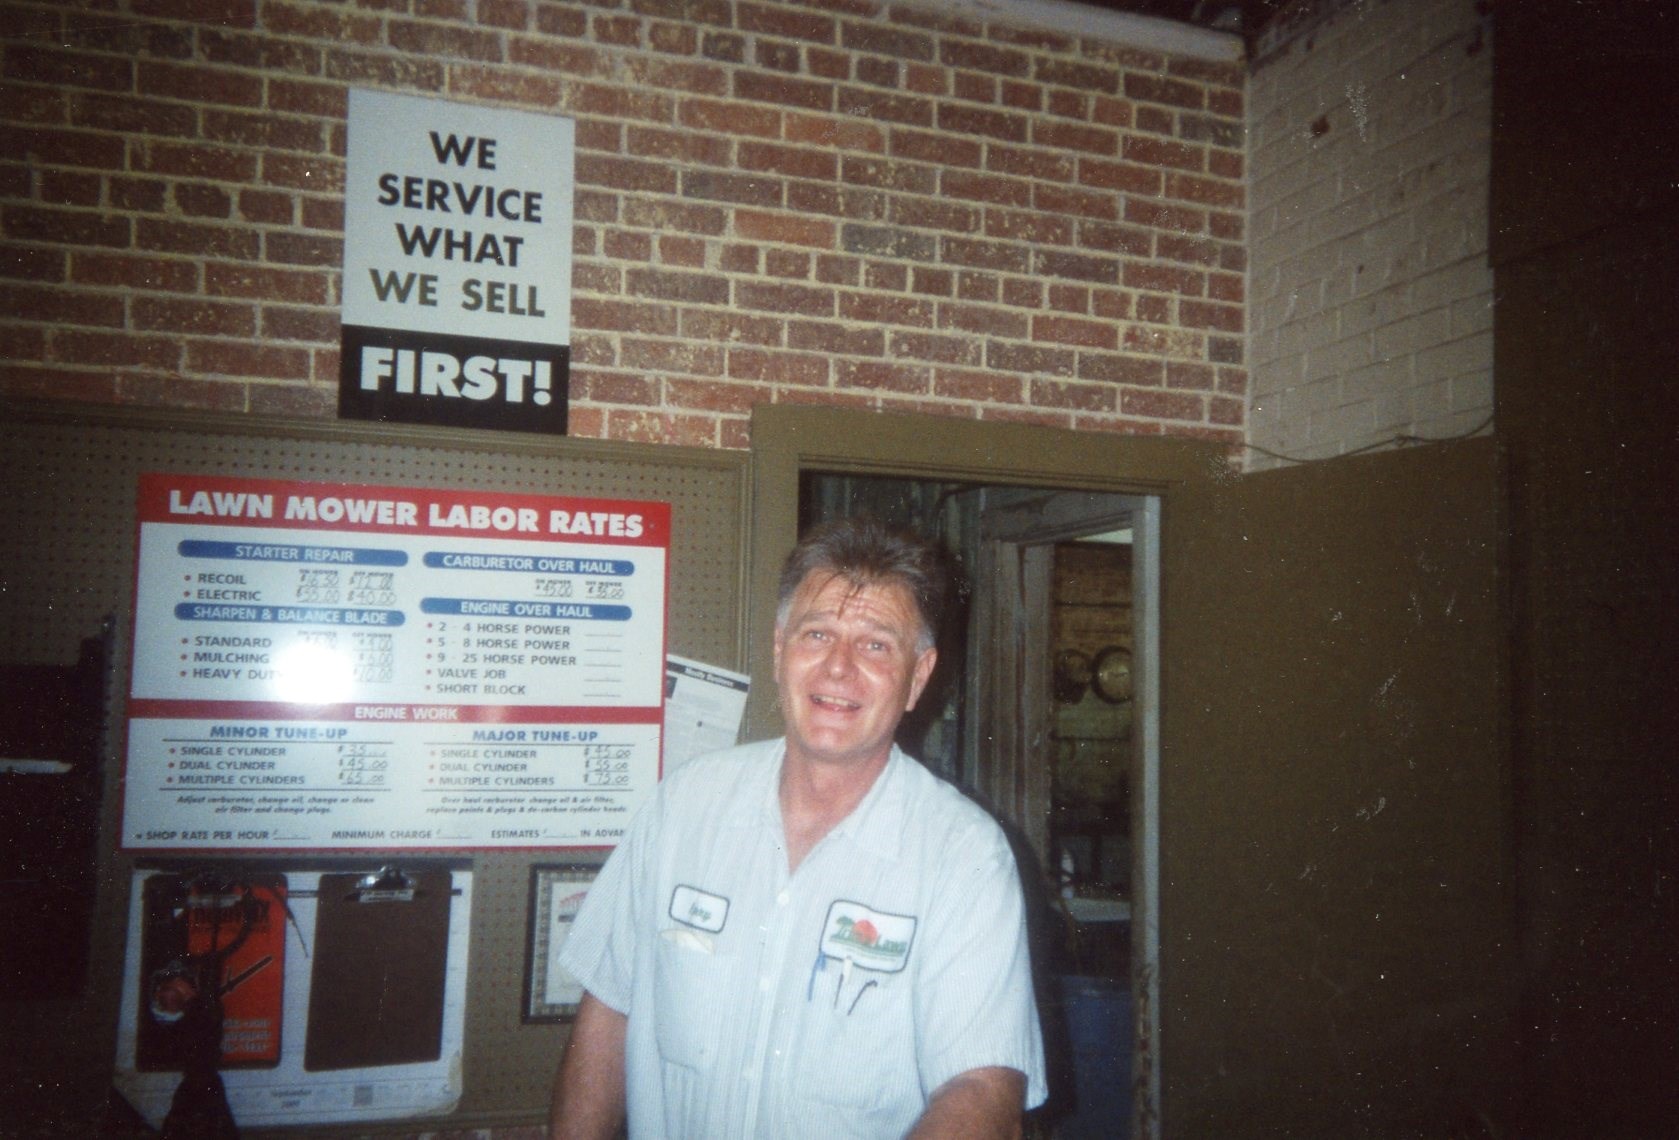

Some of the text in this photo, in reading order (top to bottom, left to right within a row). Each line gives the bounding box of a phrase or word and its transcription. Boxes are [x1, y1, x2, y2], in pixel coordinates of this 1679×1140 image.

[429, 131, 497, 170] WE
[377, 173, 543, 223] SERVICE
[395, 223, 524, 267] WHAT
[369, 268, 546, 318] WE SELL
[360, 345, 552, 406] FIRST!
[169, 489, 643, 537] LAWN MOWER LABOR RATES
[235, 545, 355, 563] STARTER REPAIR
[443, 554, 616, 574] CARBURETOR OVER HAUL
[197, 573, 247, 585] RECOIL
[197, 589, 261, 602] ELECTRIC
[193, 606, 388, 625] SHARPEN & BALANCE BLADE
[460, 602, 593, 618] ENGINE OVER HAUL
[438, 622, 570, 635] 2 4 HORSE POWER
[194, 636, 272, 648] STANDARD
[438, 637, 570, 651] 5 8 HORSE POWER
[193, 652, 270, 664] MULCHING
[437, 652, 577, 666] 9 25 HORSE POWER
[193, 668, 241, 680] HEAVY
[438, 668, 506, 680] VALVE JOB
[437, 683, 526, 695] SHORT BLOCK
[355, 706, 458, 720] ENGINE WORK
[210, 726, 348, 739] MINOR TUNE-UP
[473, 730, 599, 742] MAJOR TUNE-UP
[180, 746, 286, 757] SINGLE CYLINDER
[440, 748, 537, 759] SINGLE CYLINDER
[180, 760, 276, 770] DUAL CYLINDER
[440, 762, 527, 772] DUAL CYLINDER
[178, 775, 305, 785] MULTIPLE CYLINDERS
[439, 776, 555, 786] MULTIPLE CYLINDERS
[146, 831, 269, 840] SHOP RATE PER HOUR
[331, 830, 432, 839] MINIMUM CHARGE
[491, 830, 539, 839] ESTIMATES
